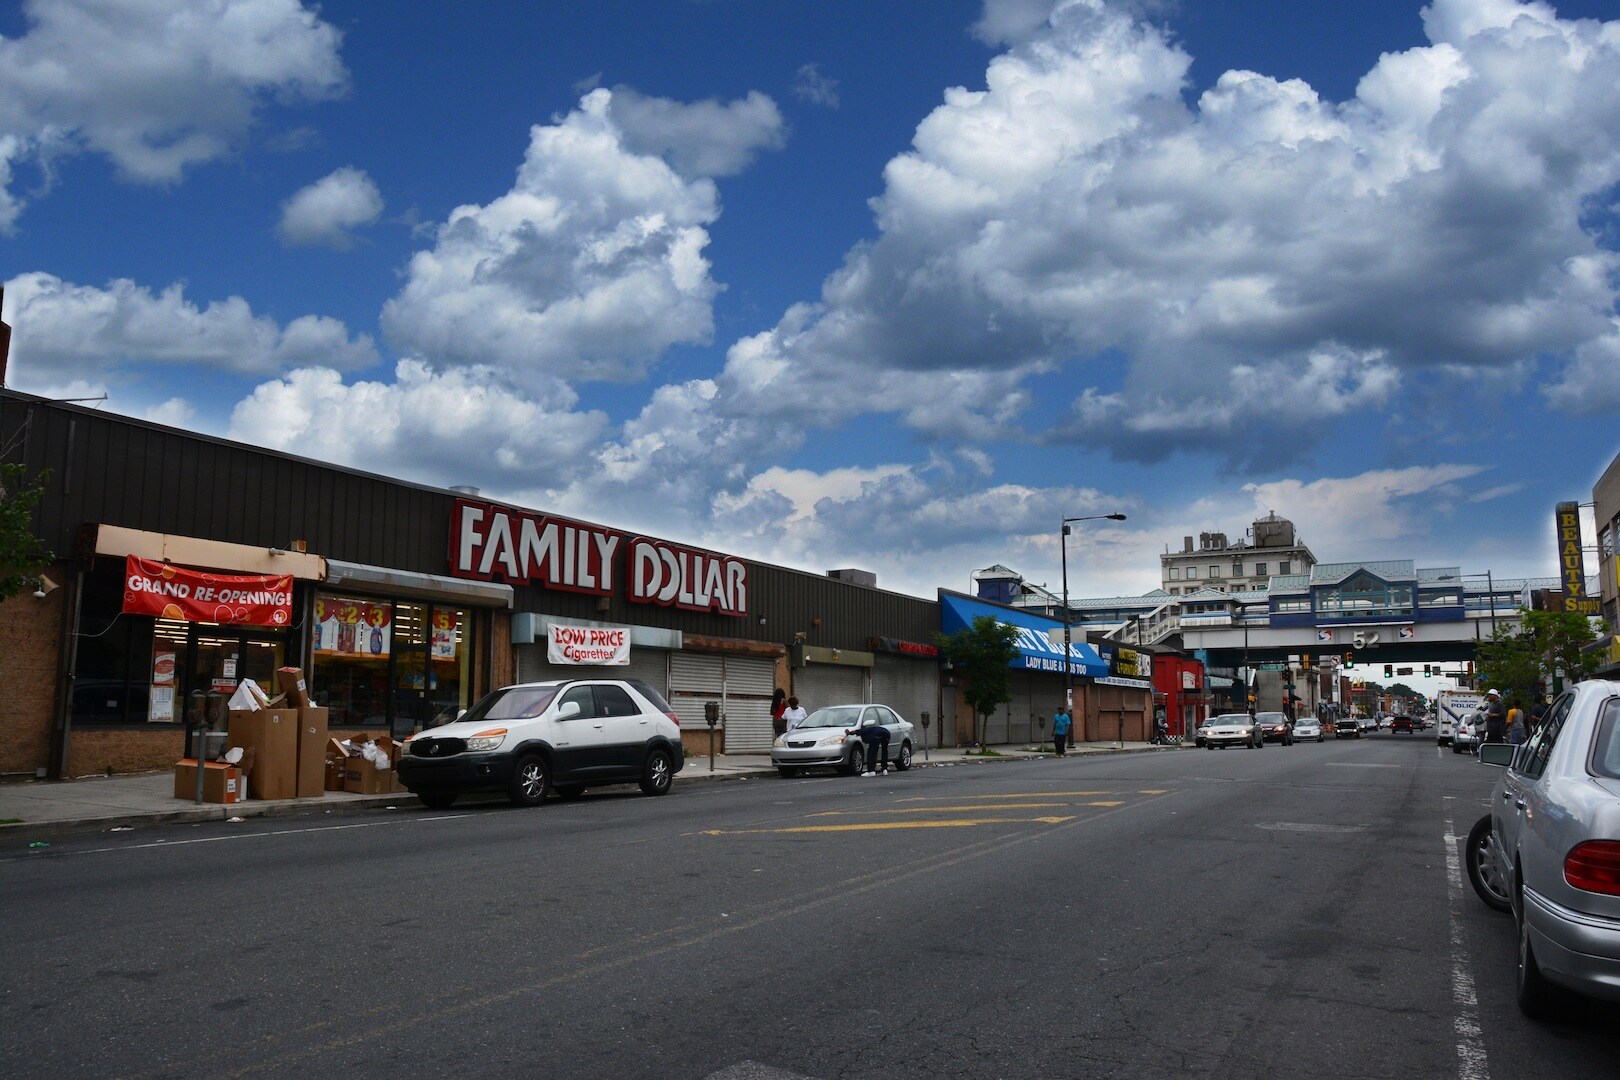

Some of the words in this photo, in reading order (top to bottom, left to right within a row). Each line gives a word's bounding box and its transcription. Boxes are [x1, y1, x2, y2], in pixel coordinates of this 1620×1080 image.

[458, 505, 620, 591] FAMILY
[633, 542, 747, 613] DOLLAR
[128, 574, 191, 600] GRAND
[193, 585, 292, 607] RE-OPENING!
[1565, 597, 1601, 614] Supply
[555, 627, 586, 645] LOW
[590, 630, 624, 647] PRICE
[1352, 630, 1380, 650] 52
[563, 645, 617, 662] Cigarettes!
[1025, 655, 1042, 670] LADY
[1042, 658, 1058, 671] BLUE
[1058, 660, 1063, 671] &
[1063, 661, 1075, 674] KDS
[1075, 663, 1087, 675] TOO
